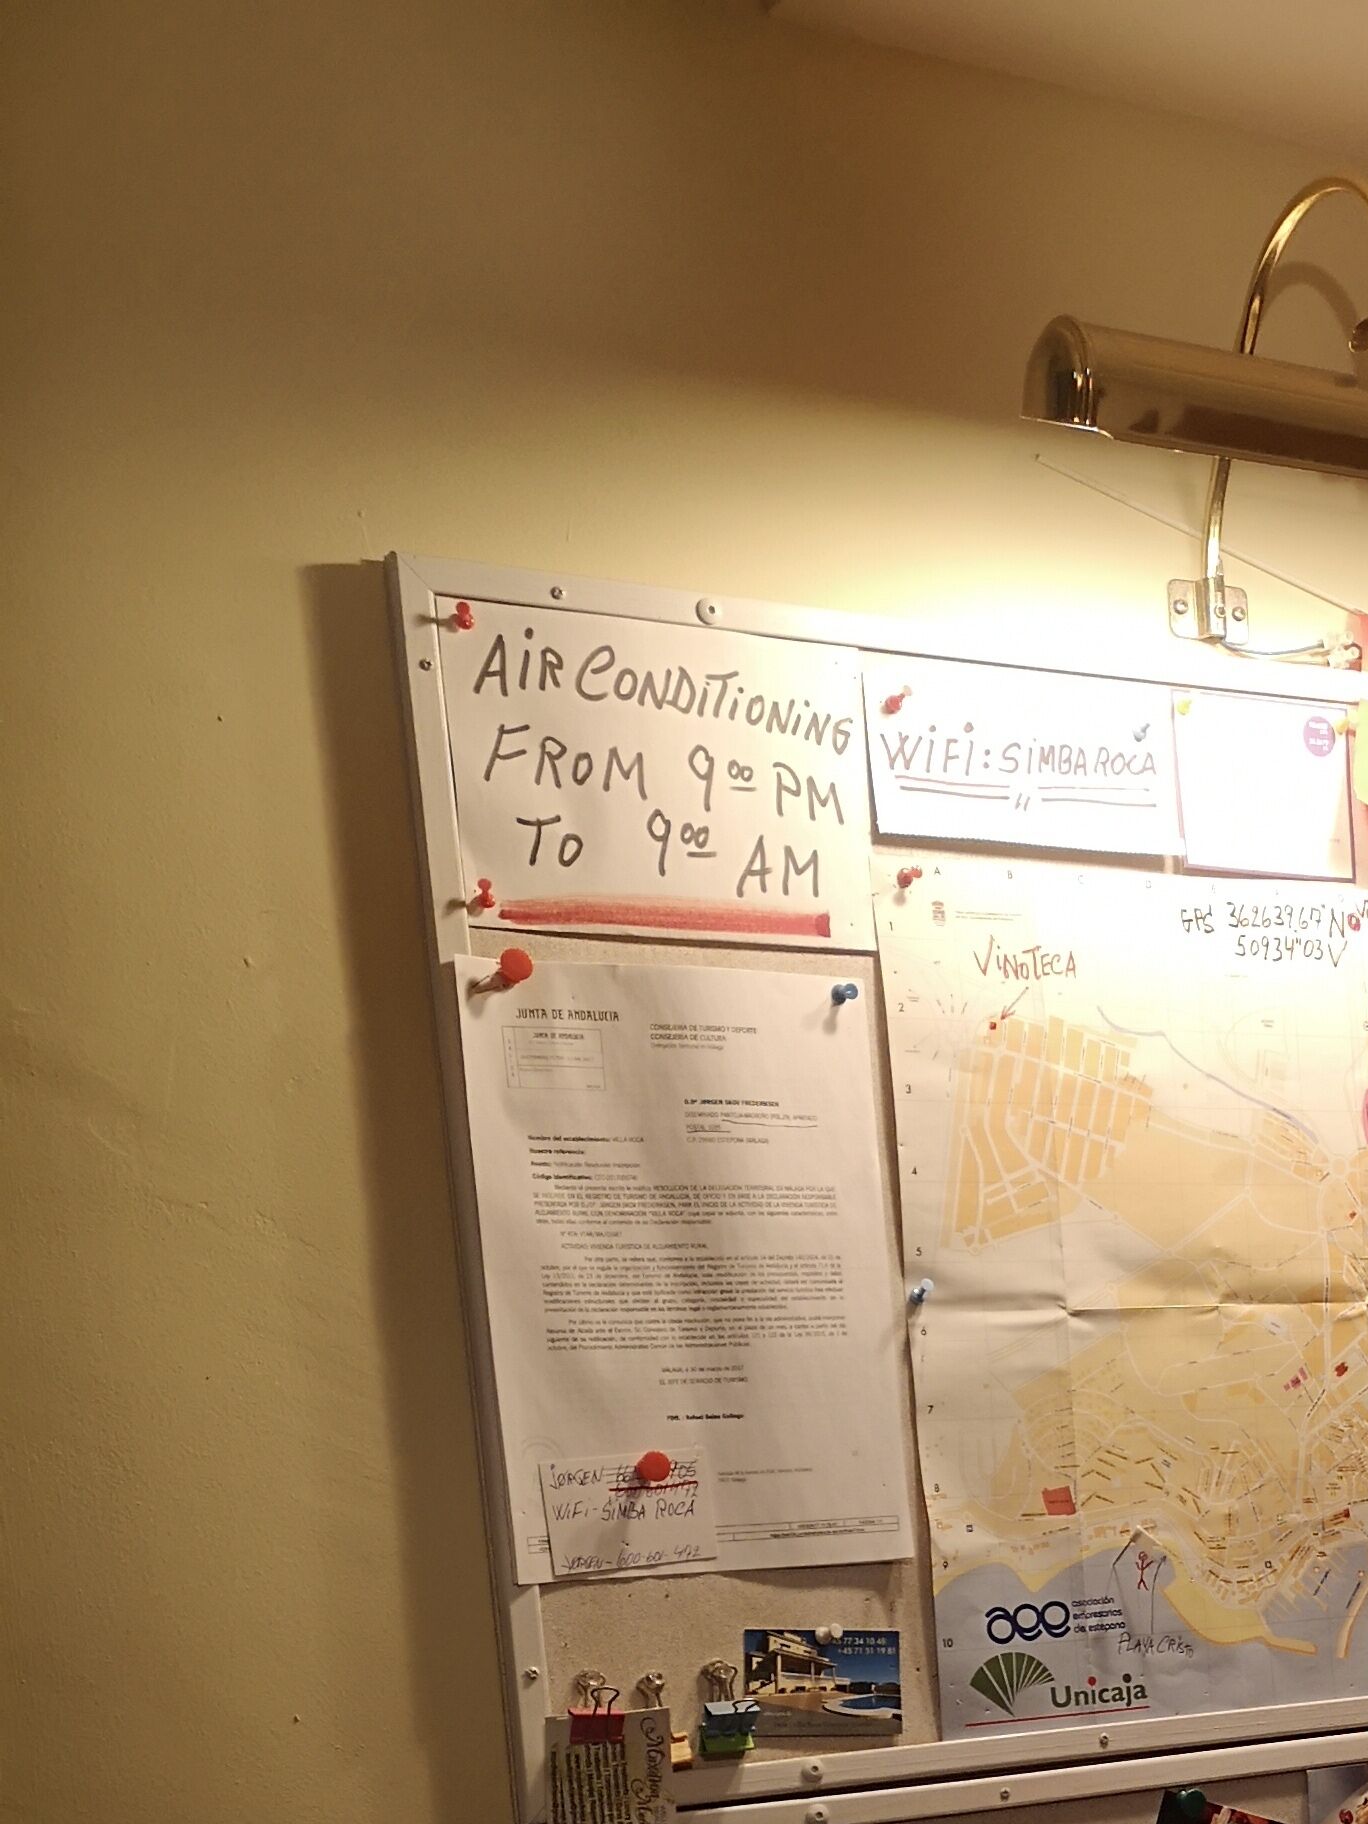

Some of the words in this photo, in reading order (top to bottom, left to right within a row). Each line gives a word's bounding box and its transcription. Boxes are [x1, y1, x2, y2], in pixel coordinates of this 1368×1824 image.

[484, 724, 648, 799] FROM
[772, 762, 844, 825] PM
[516, 815, 583, 868] TO
[737, 834, 819, 897] AM
[515, 1008, 549, 1021] JUNTA
[551, 1008, 565, 1021] DE
[1074, 1623, 1086, 1634] de
[1089, 1620, 1126, 1633] estepona
[942, 1638, 953, 1648] 10
[1049, 1672, 1148, 1708] Unicaja
